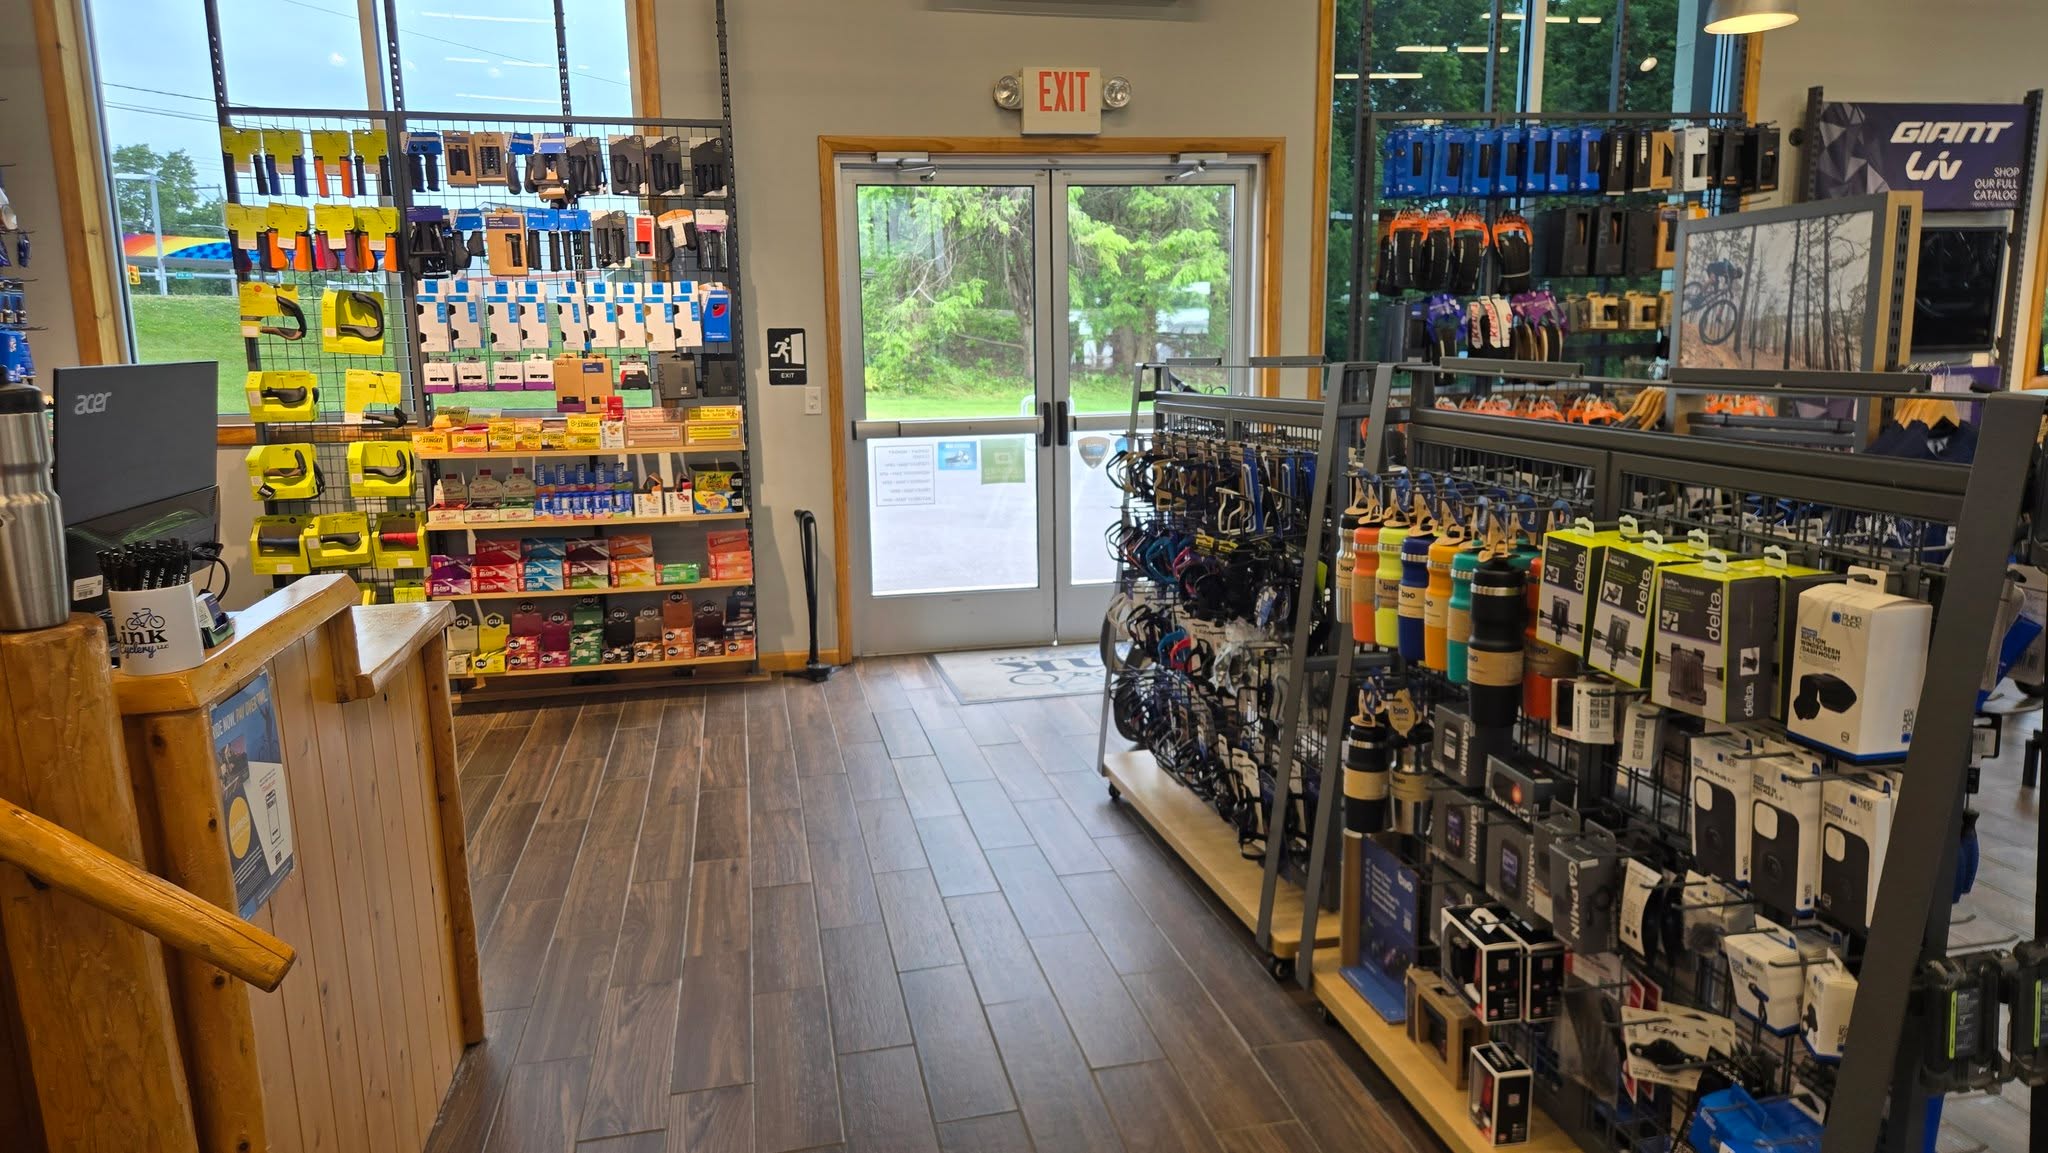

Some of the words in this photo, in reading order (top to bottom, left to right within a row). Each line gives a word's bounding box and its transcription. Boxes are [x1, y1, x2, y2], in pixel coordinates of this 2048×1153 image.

[1038, 70, 1090, 112] EXIT
[1890, 121, 2014, 144] GIANT
[1905, 150, 1963, 181] Liv
[1994, 167, 2020, 177] SHOP
[1974, 178, 1995, 188] OUR
[1996, 179, 2018, 189] FULL
[1973, 189, 2017, 201] CATALOG
[74, 391, 112, 416] acer
[1574, 550, 1586, 592] delta
[671, 593, 683, 601] GU
[1636, 566, 1652, 614] delta
[488, 618, 500, 626] GU
[551, 614, 564, 622] GU
[613, 611, 625, 619] GU
[1705, 592, 1722, 641] delta
[119, 642, 156, 659] Cyclery
[1800, 640, 1841, 655] WINDSCREEN
[1818, 650, 1841, 662] MOUNT
[1744, 683, 1754, 717] delta
[1460, 721, 1470, 777] GARMIN
[1468, 804, 1478, 865] GARMIN
